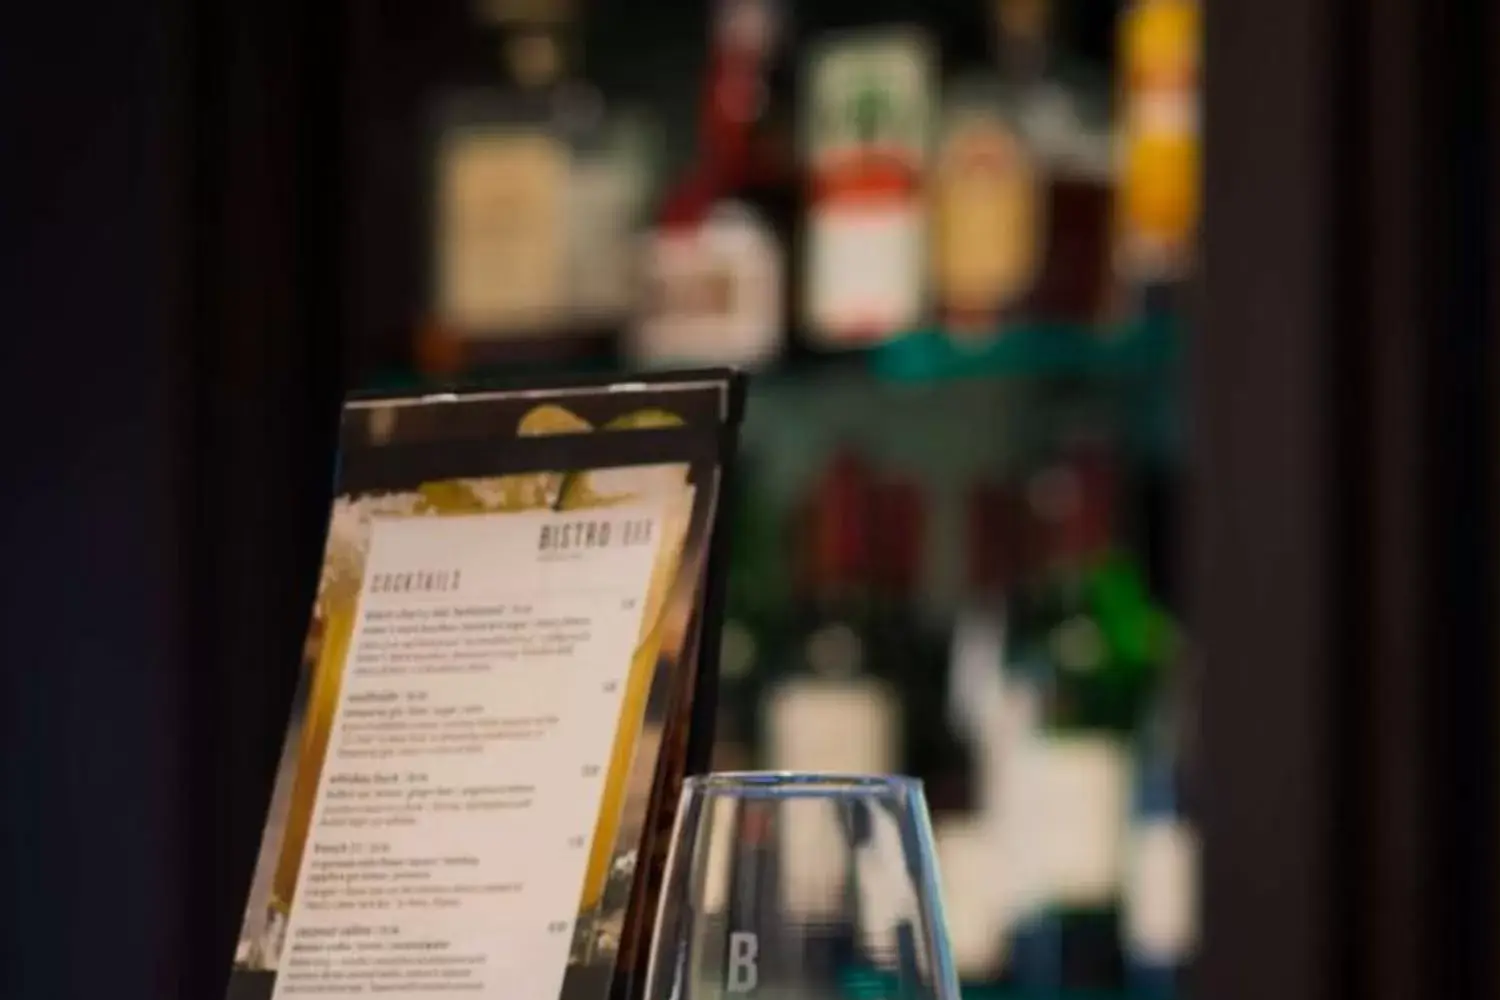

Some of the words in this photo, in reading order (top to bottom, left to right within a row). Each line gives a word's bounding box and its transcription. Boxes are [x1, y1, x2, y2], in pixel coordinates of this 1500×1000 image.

[539, 522, 610, 550] BISTRO
[370, 569, 461, 593] COCKTAILS
[727, 932, 759, 993] B
